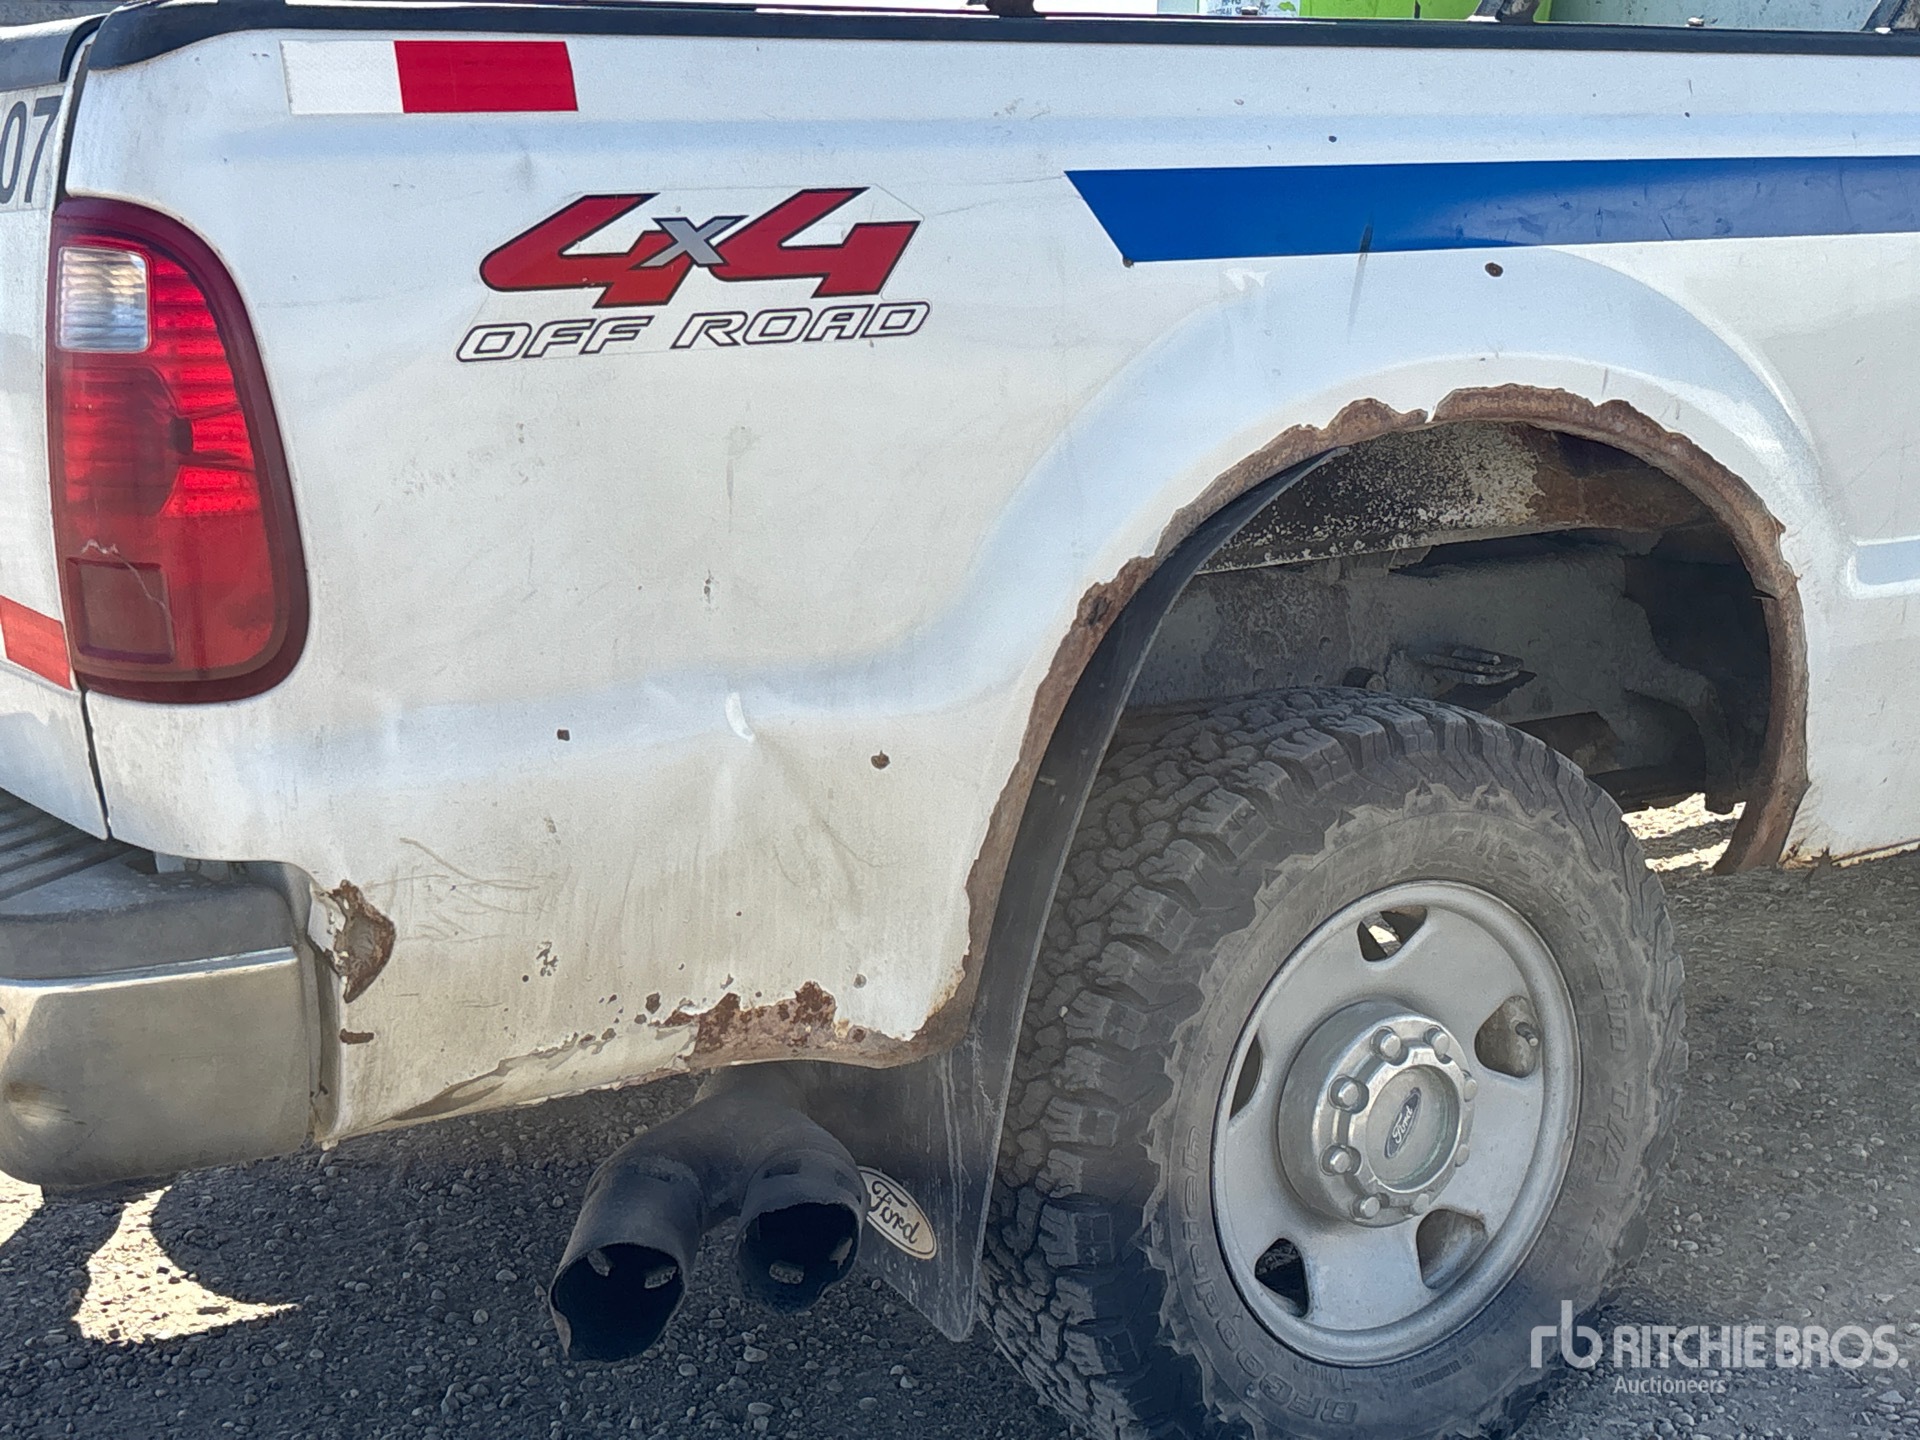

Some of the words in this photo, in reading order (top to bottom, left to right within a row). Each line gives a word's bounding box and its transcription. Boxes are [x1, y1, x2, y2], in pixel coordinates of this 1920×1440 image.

[456, 315, 655, 362] OFF
[670, 301, 931, 350] ROAD
[1392, 1105, 1413, 1144] Ford
[871, 1181, 921, 1244] Ford
